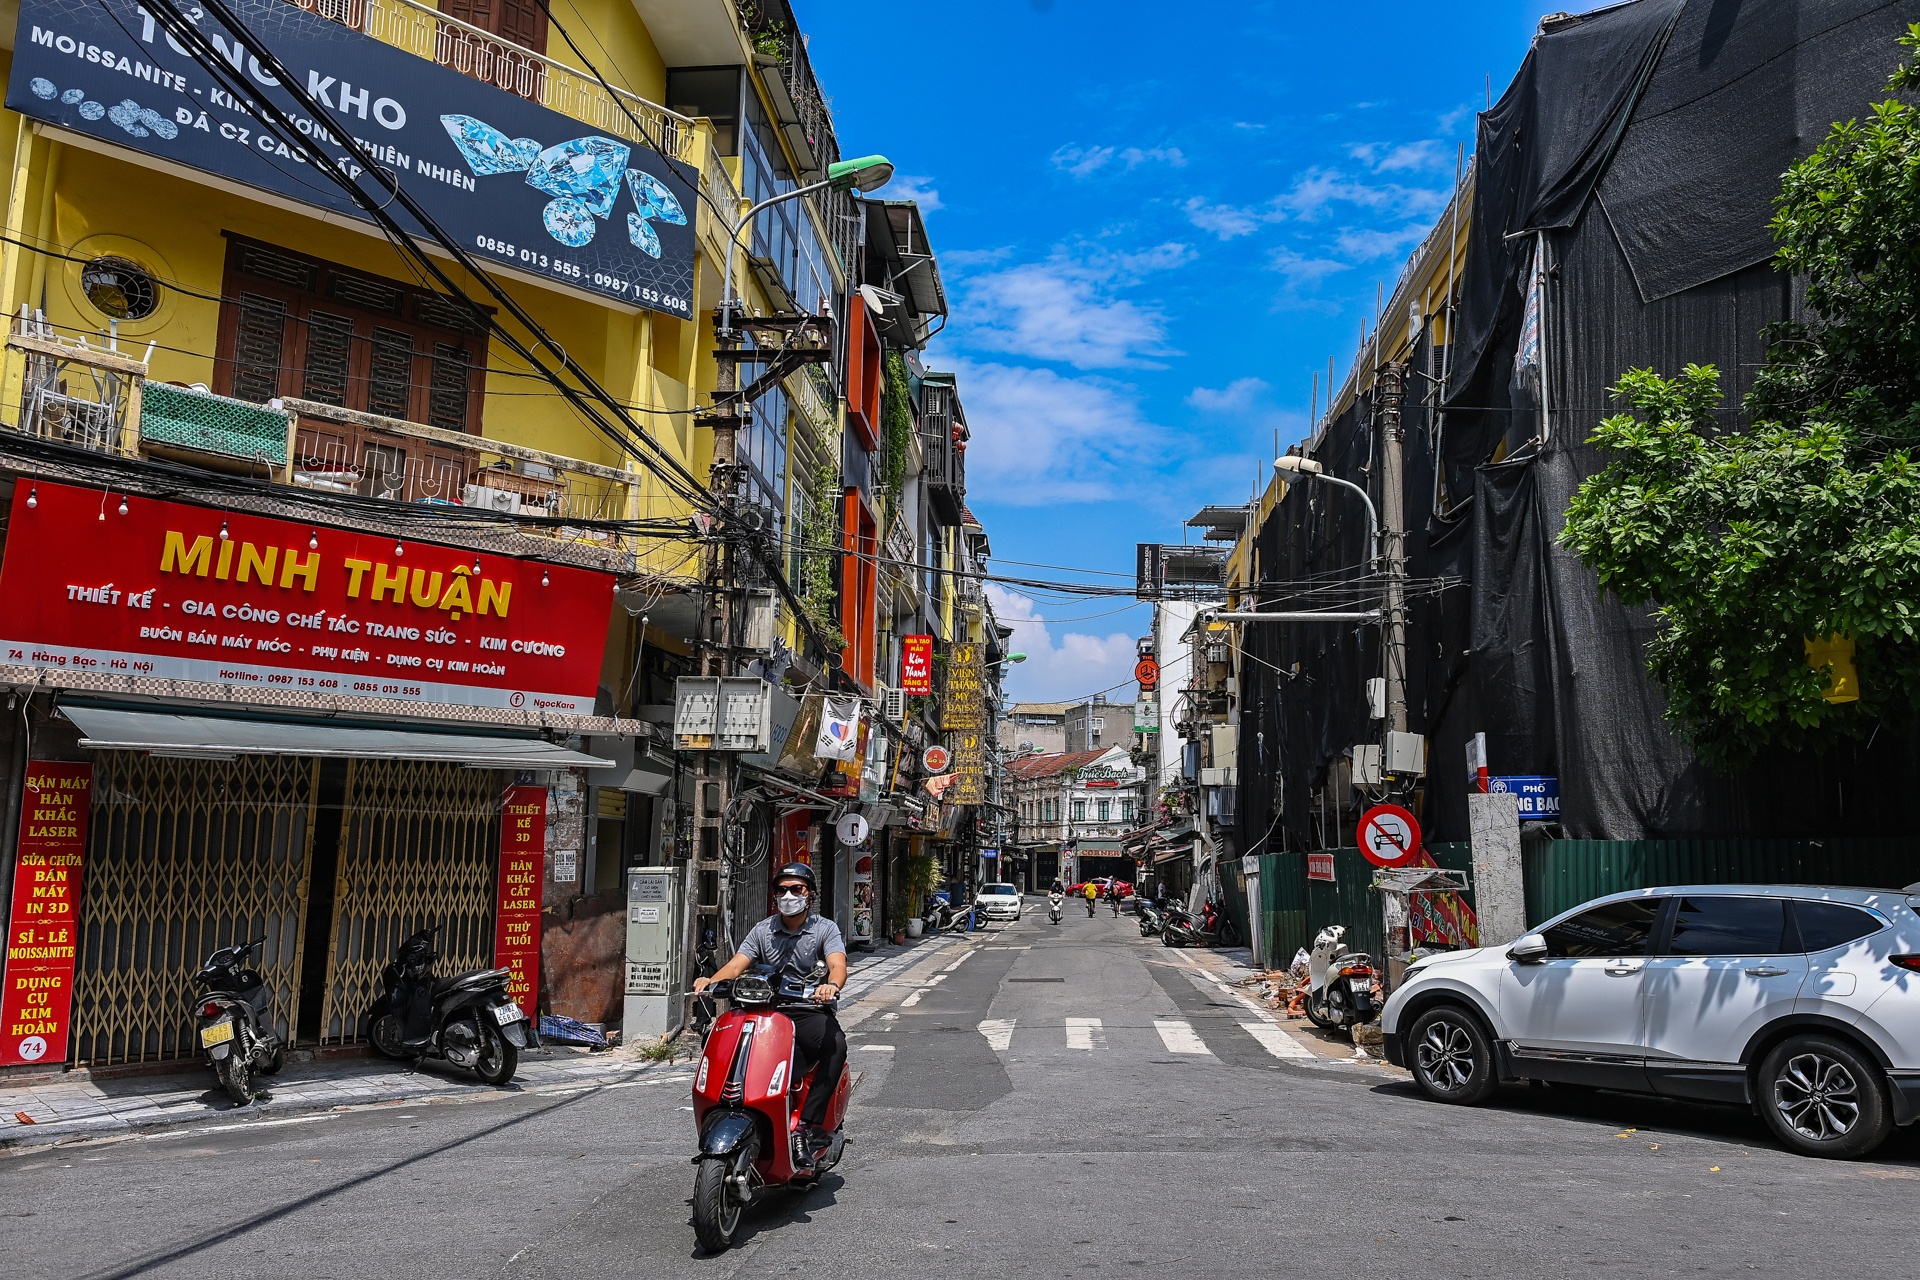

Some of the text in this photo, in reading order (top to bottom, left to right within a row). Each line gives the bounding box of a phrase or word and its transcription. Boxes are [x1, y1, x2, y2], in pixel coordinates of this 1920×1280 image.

[307, 69, 407, 130] KHO
[31, 25, 187, 93] MOISSANITE
[210, 87, 254, 116] KIM
[353, 136, 410, 169] THIÊN
[417, 159, 476, 192] NHIÊN
[176, 106, 210, 133] ĐÁ
[219, 122, 250, 145] CZ
[257, 135, 309, 163] CAO
[476, 235, 516, 258] 0855
[520, 245, 549, 268] 013
[553, 259, 581, 279] 555
[594, 272, 629, 293] 0987
[634, 284, 659, 303] 153
[663, 292, 687, 312] 608
[160, 530, 512, 621] MINH THUẬN
[66, 583, 121, 606] THIẾT
[127, 588, 157, 609] KẾ
[181, 599, 217, 617] GIA
[222, 602, 280, 625] CÔNG
[286, 609, 327, 630] CHẾ
[327, 615, 360, 634] TÁC
[365, 621, 421, 641] TRANG
[424, 626, 457, 645] SỨC
[479, 636, 507, 651] KIM
[510, 639, 566, 658] CƯƠNG
[139, 625, 183, 643] BUÔN
[187, 629, 217, 646] BÁN
[221, 634, 253, 650] MÁY
[256, 637, 292, 653] MÓC
[311, 644, 338, 661] PHỤ
[340, 648, 370, 664] KIỆN
[386, 653, 422, 669] DỤNG
[425, 657, 444, 672] CỤ
[447, 659, 470, 673] KIM
[471, 660, 506, 676] HOÀN
[8, 649, 23, 660] 74
[31, 650, 66, 666] Hàng
[72, 655, 98, 668] Bạc
[110, 658, 128, 671] Hà
[132, 660, 154, 674] Nội
[219, 669, 264, 683] Hotline:
[267, 673, 295, 686] 0987
[297, 676, 315, 687] 153
[318, 677, 338, 689] 608
[353, 681, 378, 692] 0855
[382, 684, 399, 694] 013
[402, 685, 421, 696] 555
[533, 698, 576, 711] NgocKara
[947, 703, 977, 712] DAISY
[955, 751, 982, 759] DAISY
[955, 766, 983, 774] CLINIC
[27, 775, 89, 790] BÁN MÁY
[961, 785, 977, 793] SPA
[1522, 782, 1546, 793] PHỐ
[40, 791, 73, 805] HÀN
[33, 807, 76, 821] KHẮC
[508, 804, 541, 815] THIẾT
[516, 817, 531, 828] KẾ
[29, 825, 78, 838] LASER
[516, 833, 531, 842] 3D
[21, 852, 83, 866] SỬA CHỮA
[1081, 849, 1121, 857] CORNER
[510, 860, 533, 871] HÀN
[35, 868, 67, 882] BÁN
[506, 871, 536, 884] KHẮC
[32, 884, 67, 898] MÁY
[510, 884, 531, 896] CẮT
[26, 902, 70, 914] IN 3D
[503, 899, 536, 910] LASER
[506, 921, 531, 933] THỬ
[18, 928, 35, 944] SỈ
[48, 928, 69, 944] LẺ
[505, 934, 532, 946] TUỔI
[8, 945, 75, 960] MOISSANITE
[511, 959, 523, 968] XI
[508, 971, 525, 982] MẠ
[16, 976, 62, 992] DỤNG
[27, 992, 49, 1007] CỤ
[20, 1007, 52, 1020] KIM
[11, 1020, 58, 1036] HOÀN
[23, 1042, 43, 1054] 74
